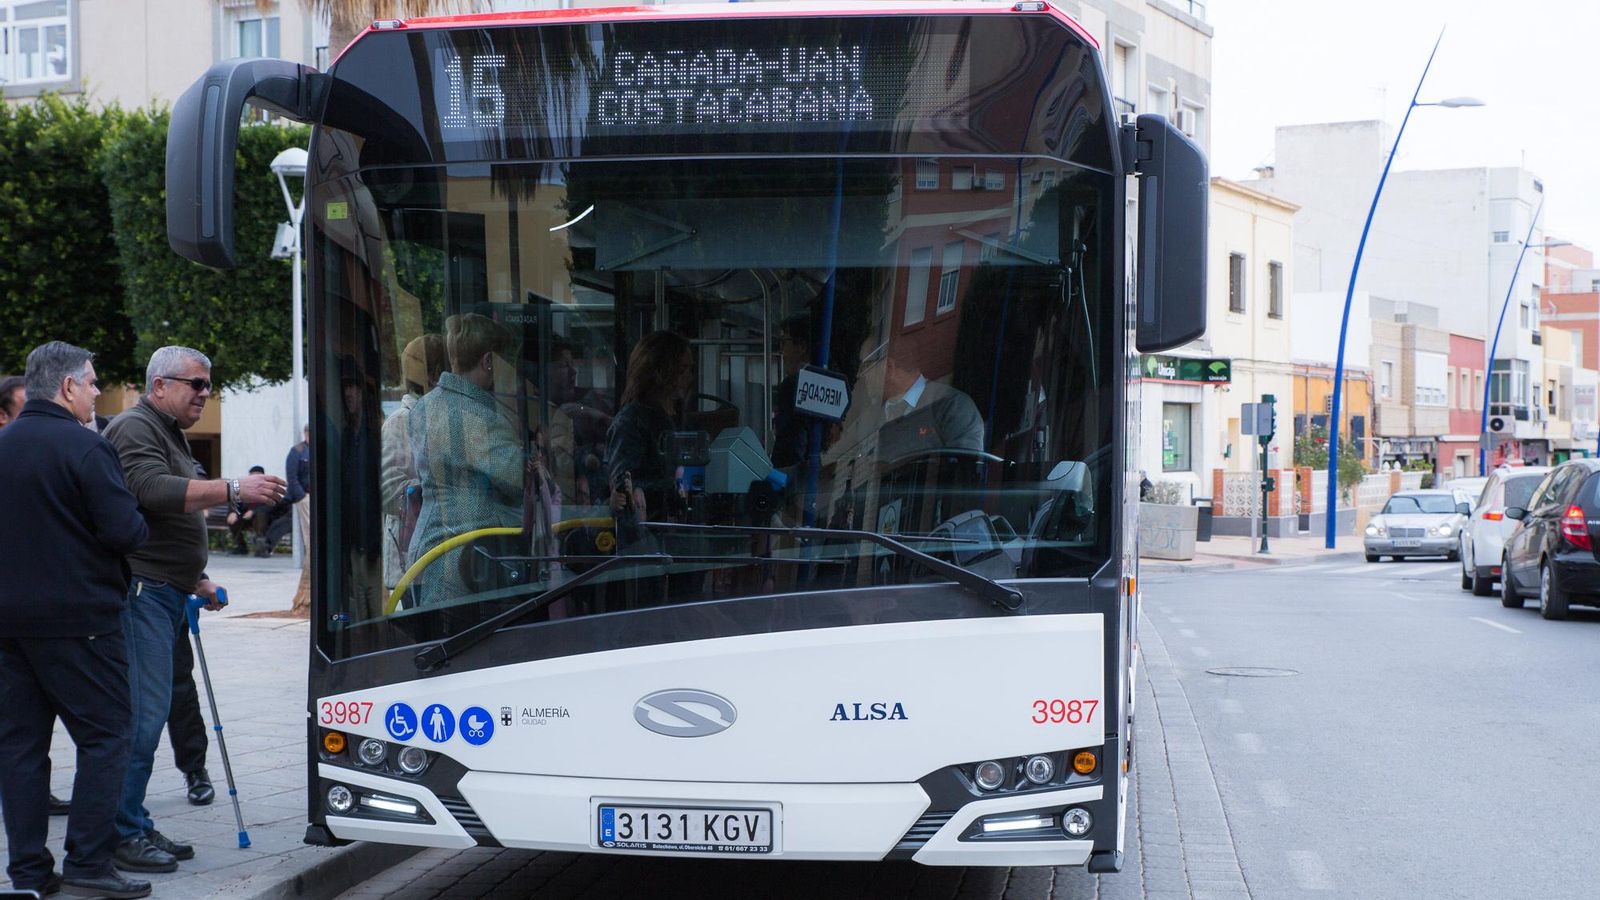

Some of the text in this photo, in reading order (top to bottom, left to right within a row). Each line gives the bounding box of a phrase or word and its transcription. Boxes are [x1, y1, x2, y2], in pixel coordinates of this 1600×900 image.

[444, 55, 505, 128] 15
[598, 86, 873, 125] COSTACABANA
[320, 701, 374, 725] 3987
[521, 705, 570, 718] ALMERÍA
[829, 702, 909, 721] ALSA
[1031, 699, 1099, 724] 3987
[605, 828, 612, 837] E
[617, 812, 760, 842] 3131 KGV
